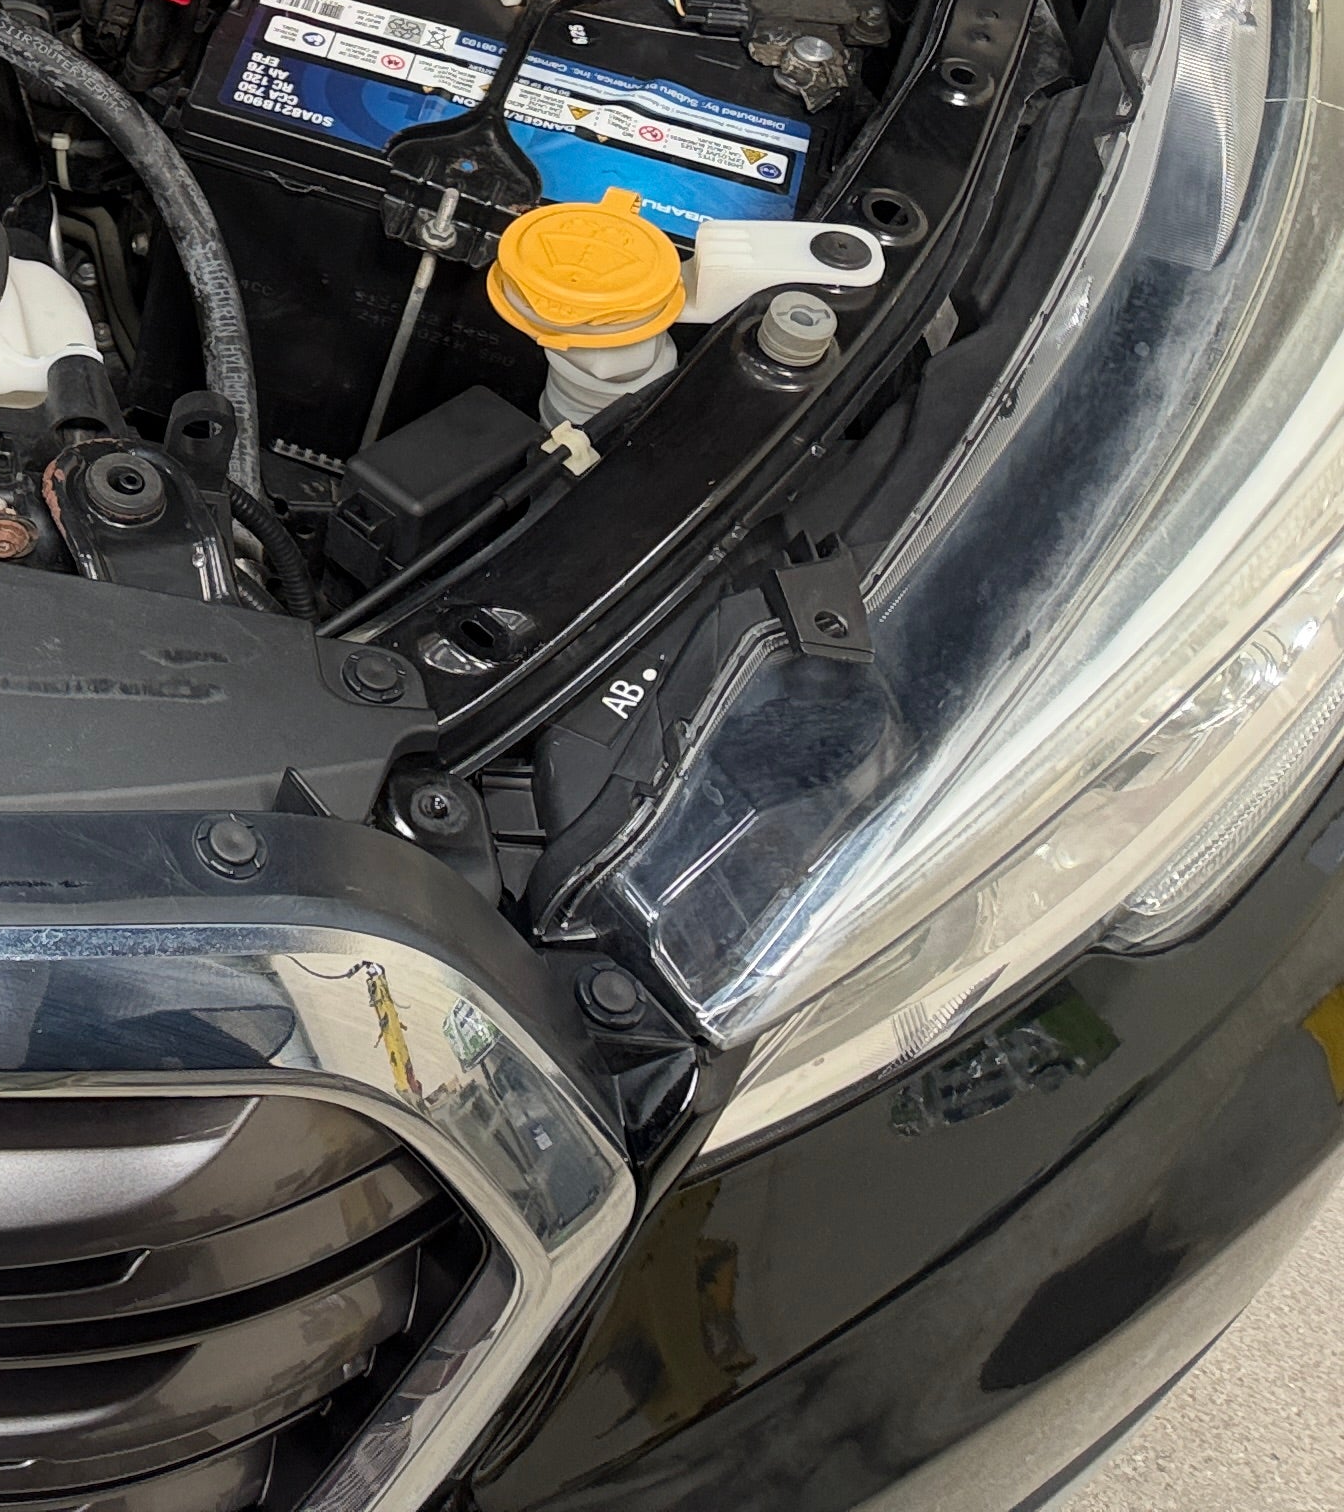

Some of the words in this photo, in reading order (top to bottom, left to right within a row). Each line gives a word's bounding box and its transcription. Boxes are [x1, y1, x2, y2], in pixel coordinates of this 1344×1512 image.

[525, 53, 568, 72] Camde
[241, 70, 269, 85] 120
[267, 66, 289, 80] Ah
[236, 79, 265, 96] 750
[270, 78, 294, 93] RC
[267, 88, 299, 105] CCA
[658, 84, 698, 107] Subaru
[451, 94, 575, 133] DANGER/ON
[721, 106, 785, 131] Distributed
[641, 197, 713, 222] UBARU
